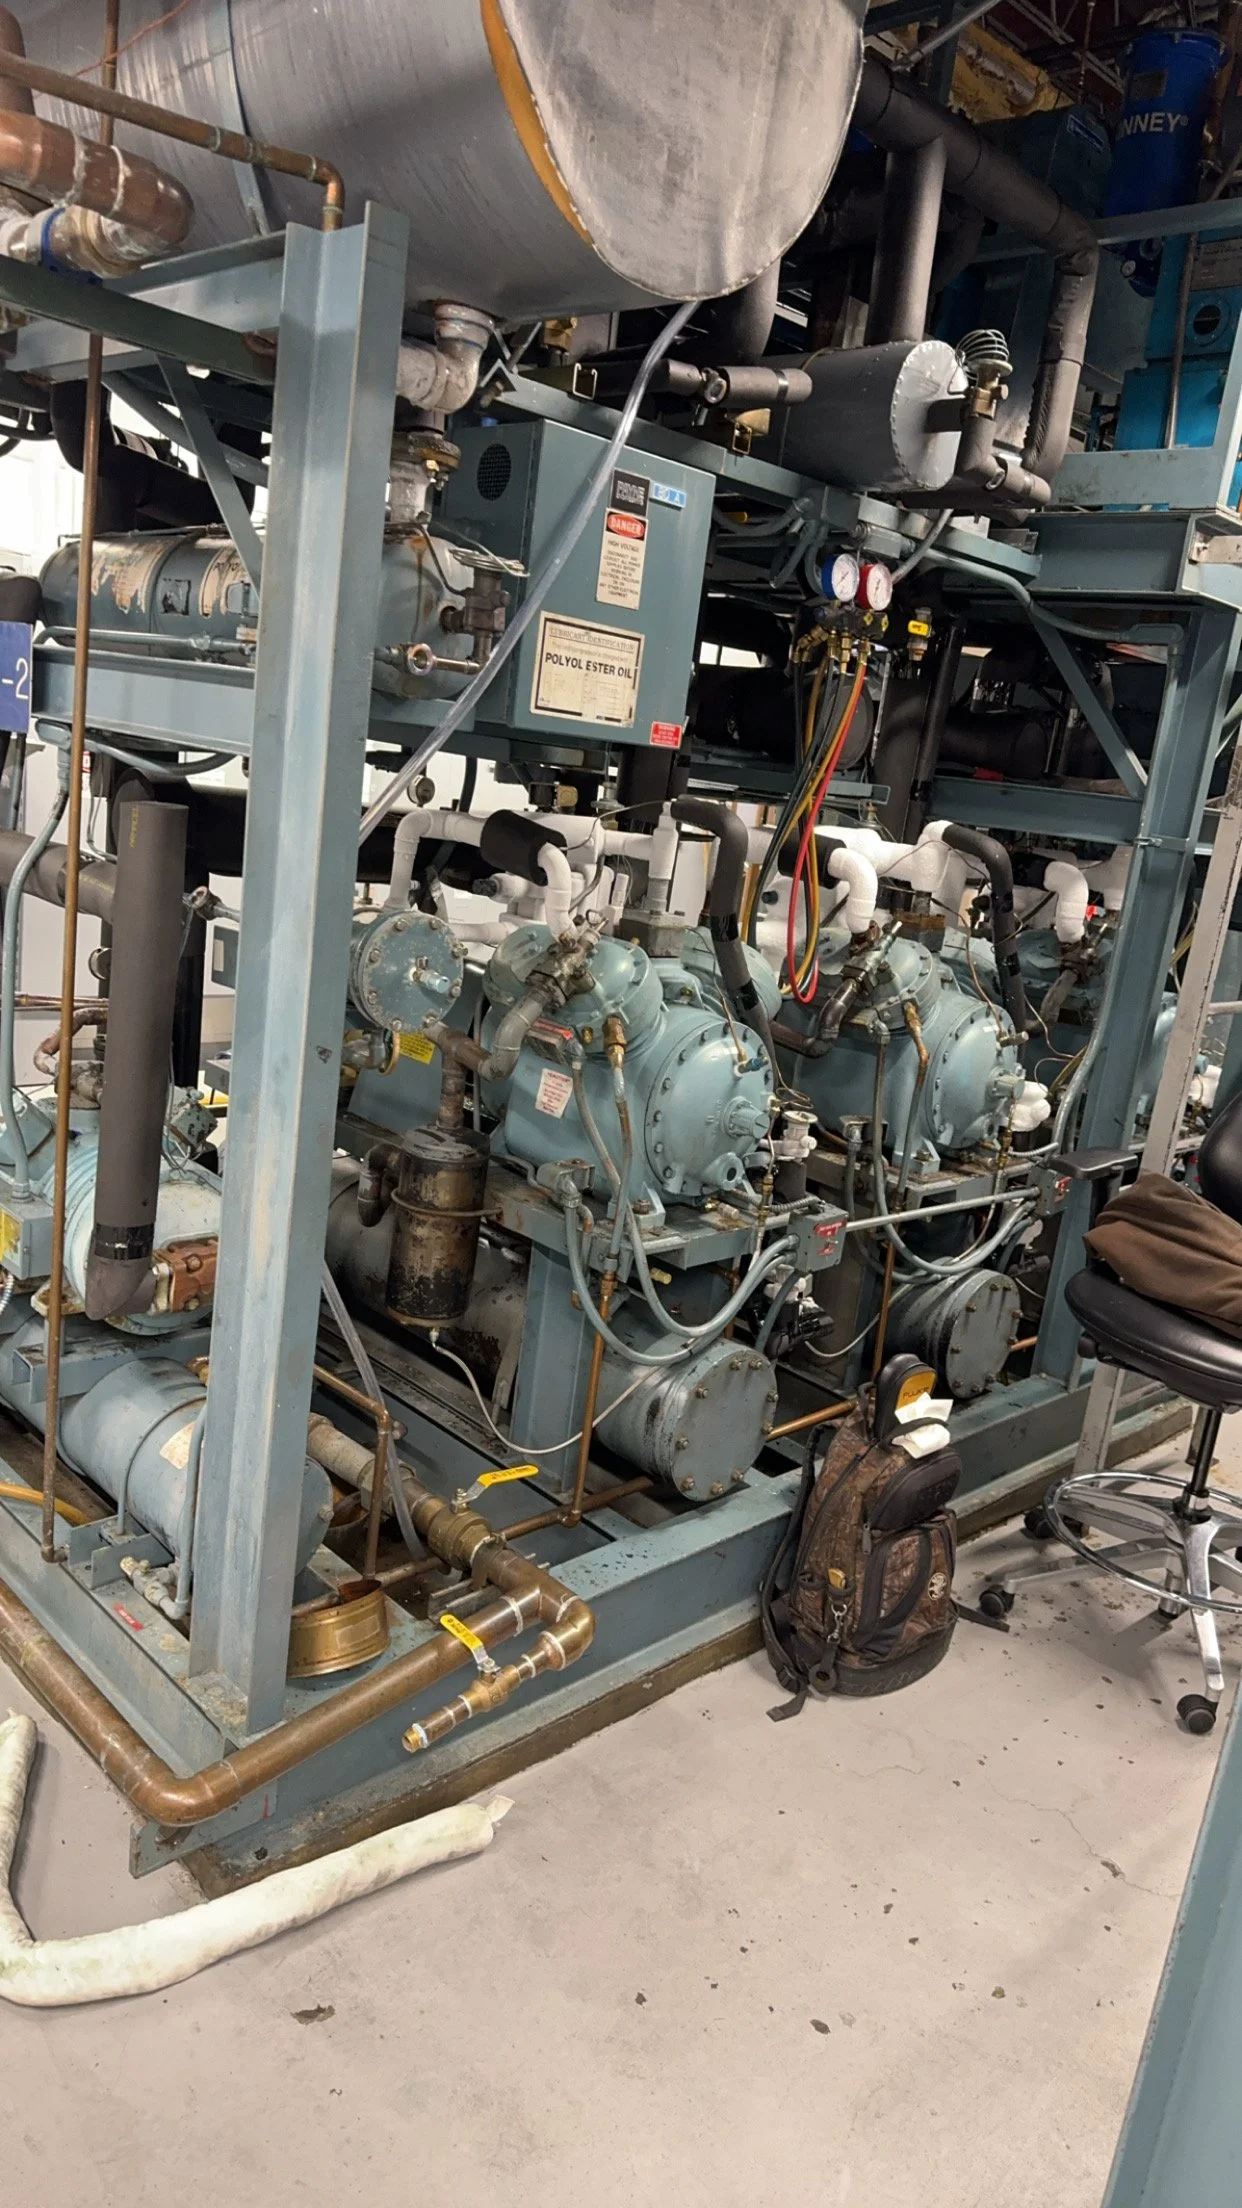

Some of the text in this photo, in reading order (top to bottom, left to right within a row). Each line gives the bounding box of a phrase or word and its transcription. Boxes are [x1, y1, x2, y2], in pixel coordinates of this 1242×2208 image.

[611, 517, 642, 536] DANGER
[545, 652, 583, 670] POLYOL
[585, 660, 615, 676] ESTER
[617, 667, 632, 679] OIL
